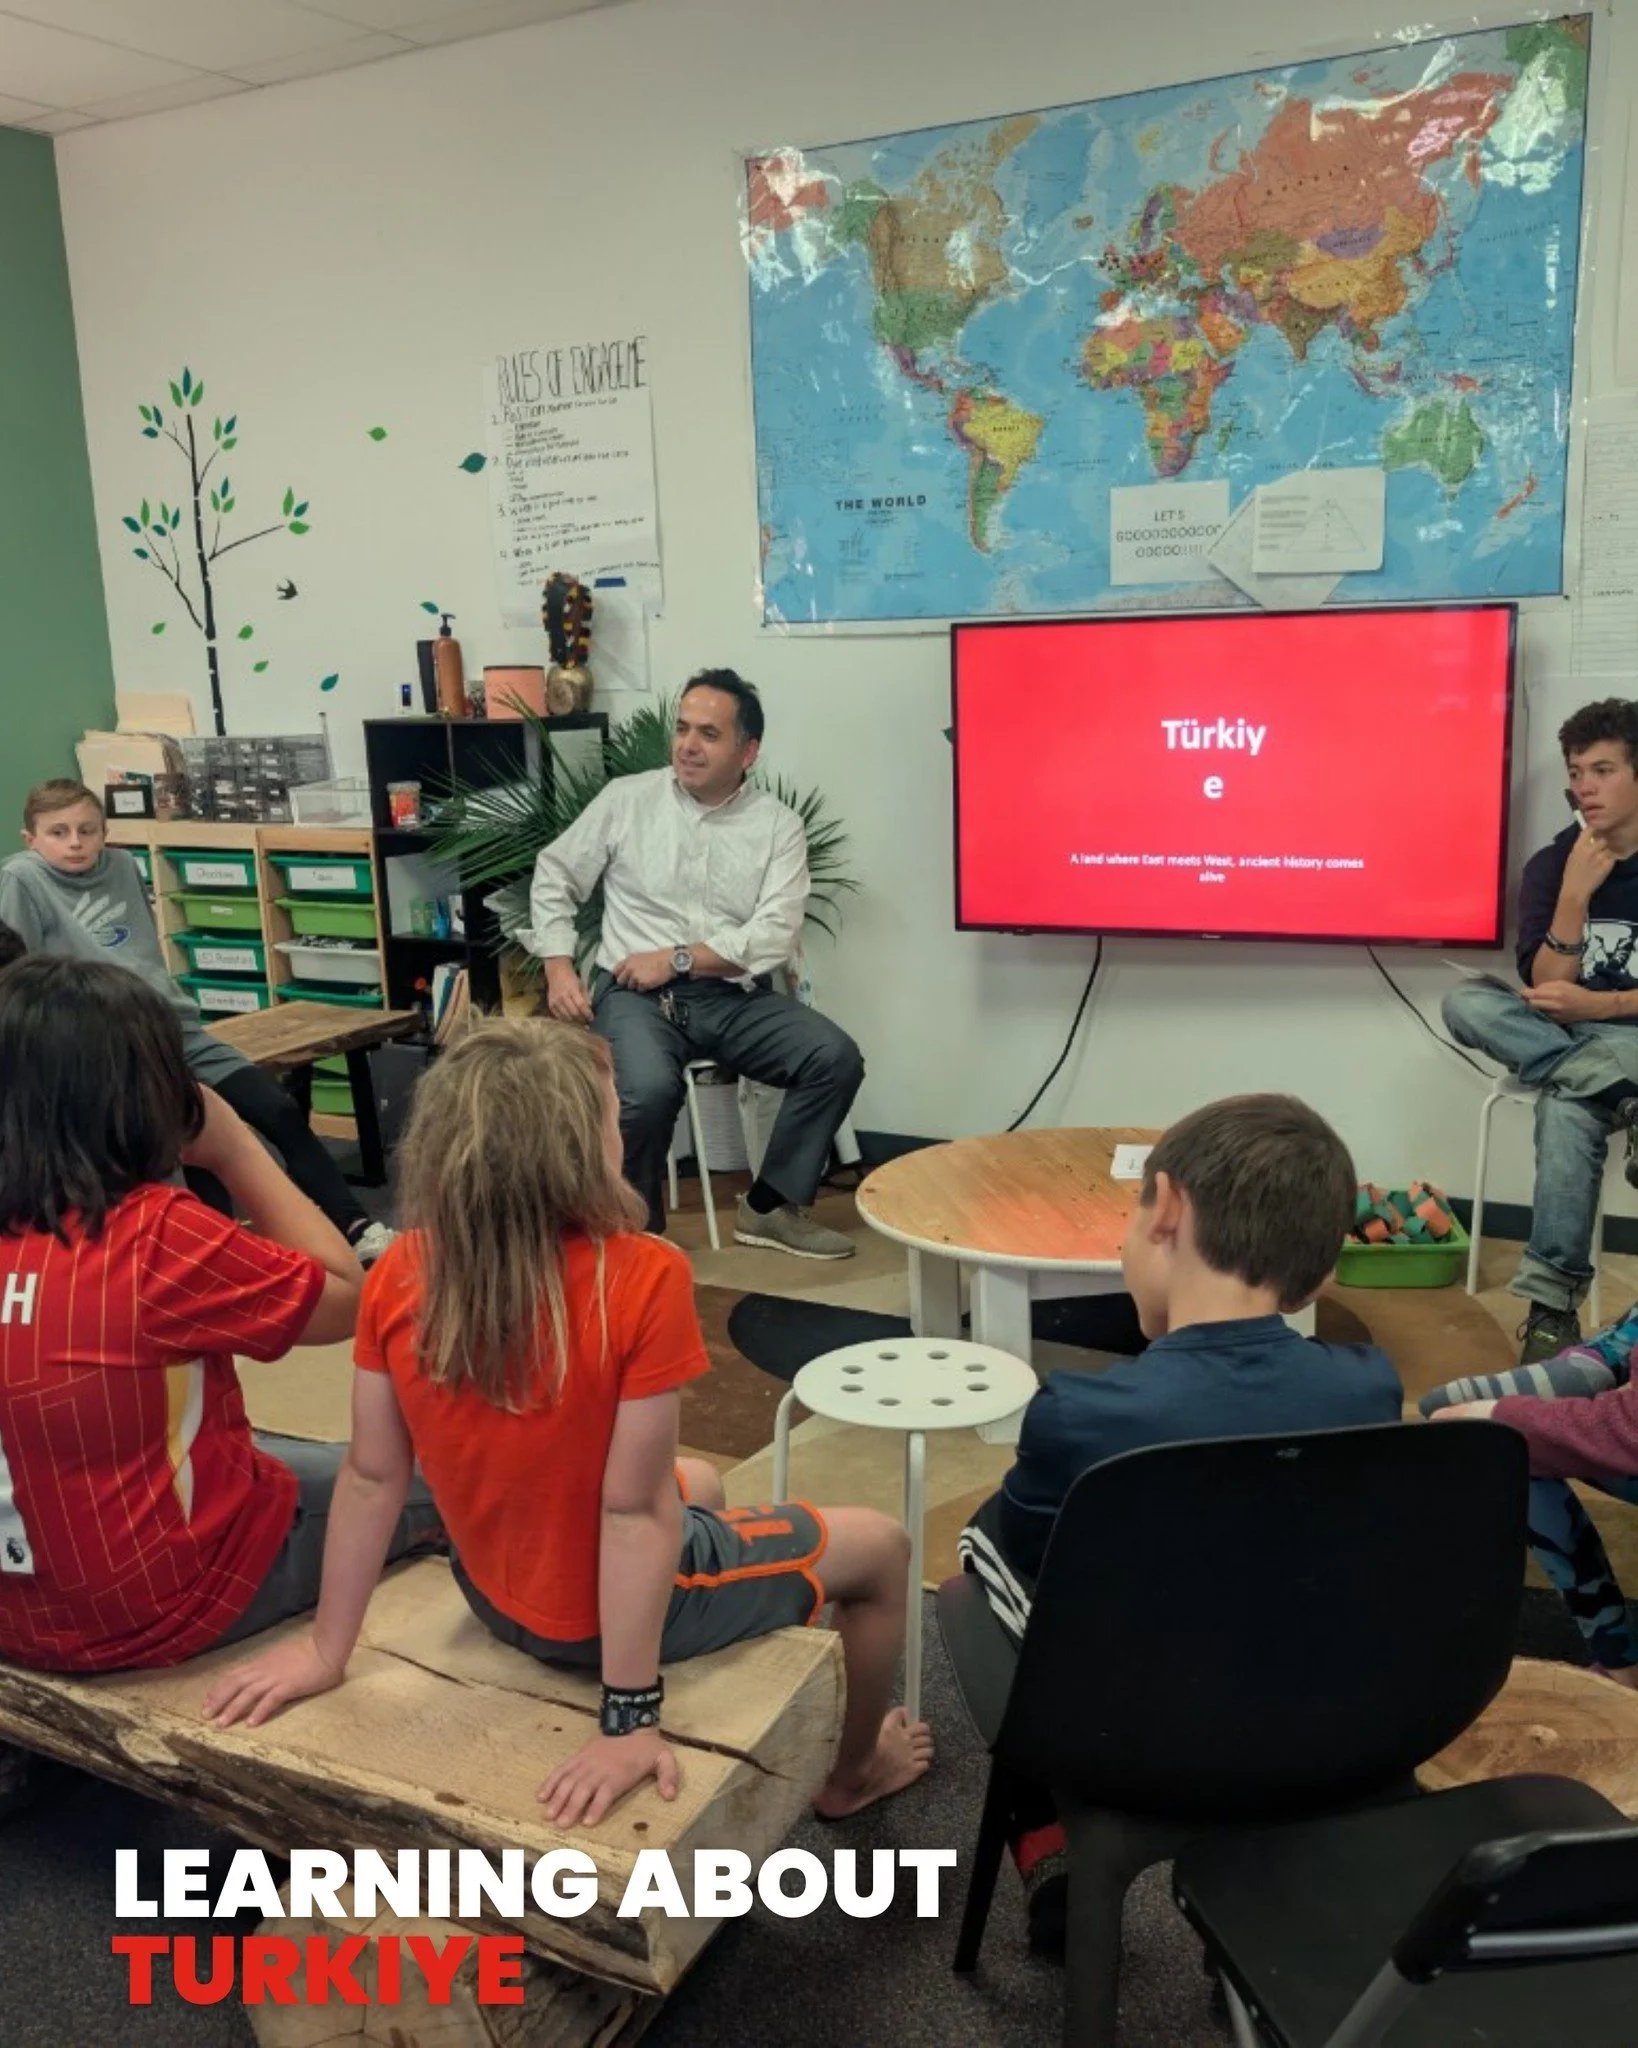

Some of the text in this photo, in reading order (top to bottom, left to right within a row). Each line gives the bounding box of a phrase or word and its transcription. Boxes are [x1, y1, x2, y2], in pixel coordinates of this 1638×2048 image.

[834, 495, 927, 511] THE WORLD
[1160, 717, 1267, 756] Türkiy
[1203, 775, 1224, 799] e
[1071, 854, 1364, 871] A land where East meets West, ancient history comes
[1199, 871, 1226, 883] alive
